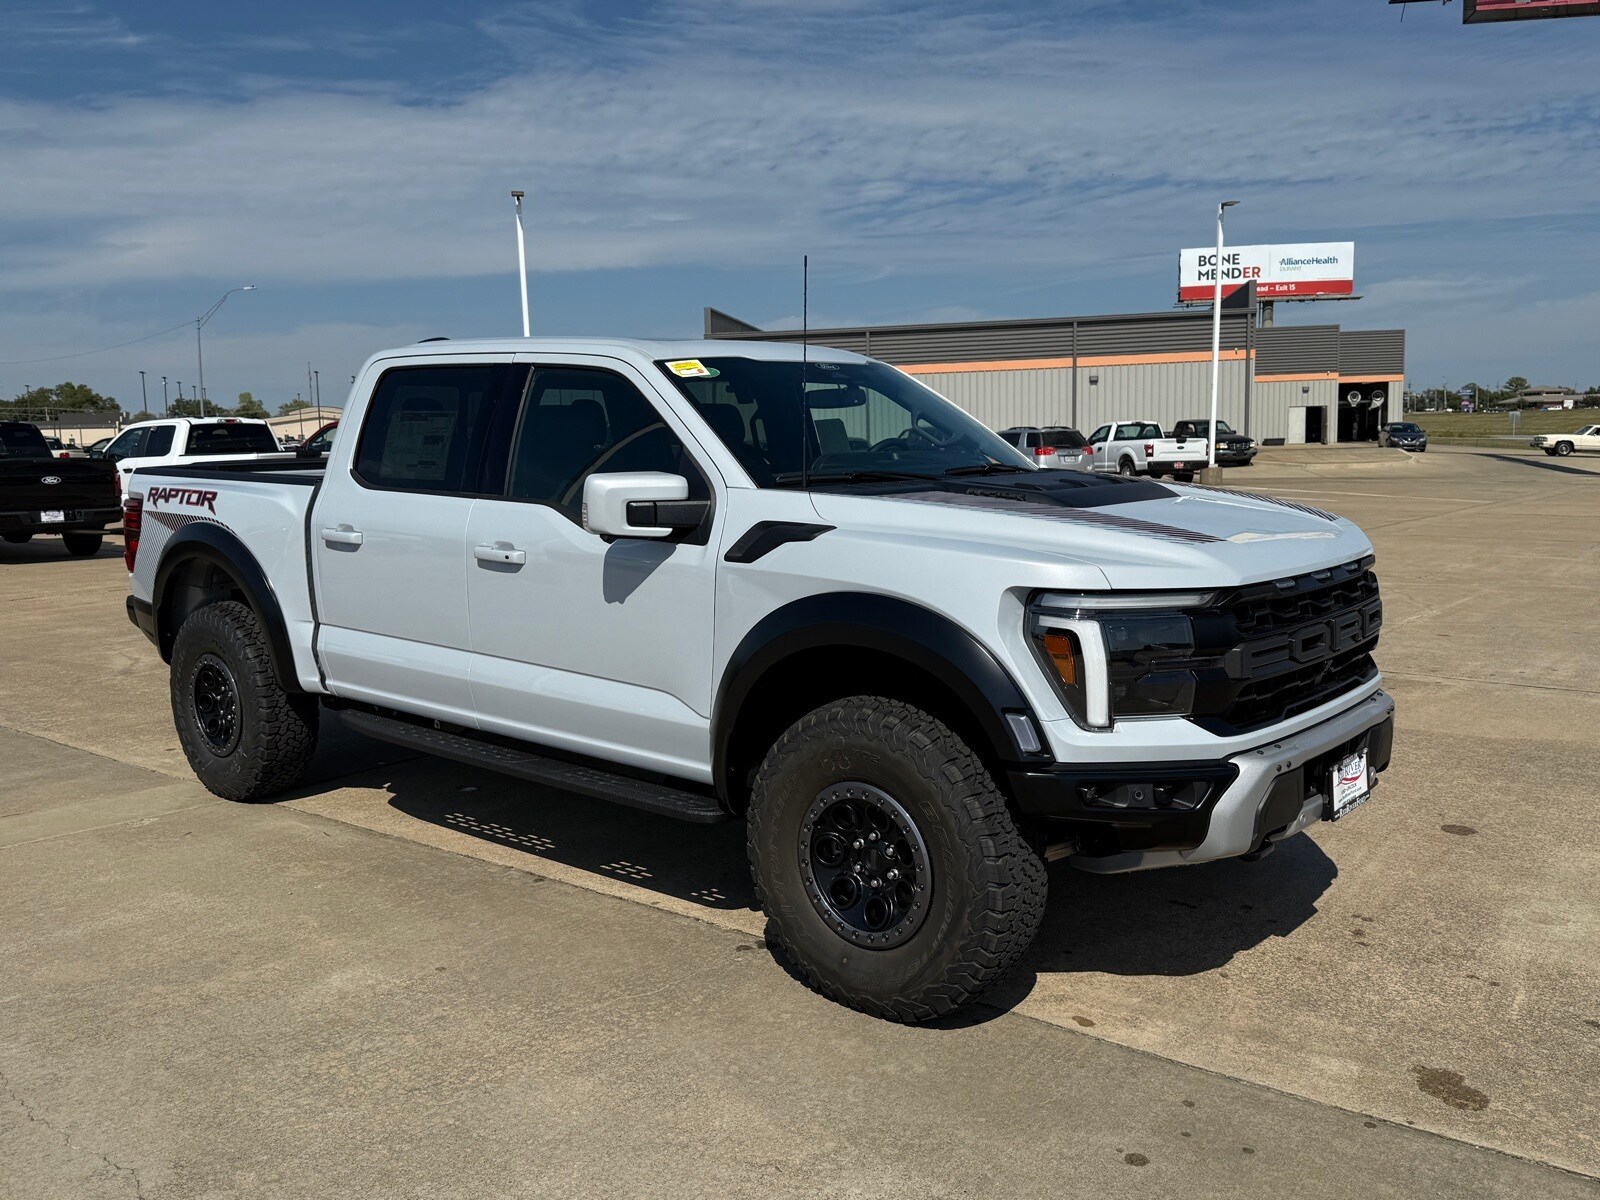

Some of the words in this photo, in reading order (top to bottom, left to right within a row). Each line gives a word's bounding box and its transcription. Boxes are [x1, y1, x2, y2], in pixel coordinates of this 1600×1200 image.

[1198, 253, 1240, 267] BONE
[1279, 256, 1338, 266] AllianceHealth
[1198, 266, 1261, 281] MENDER
[1289, 283, 1296, 291] 15
[147, 486, 218, 516] RAPTOR
[1225, 598, 1383, 679] FORD
